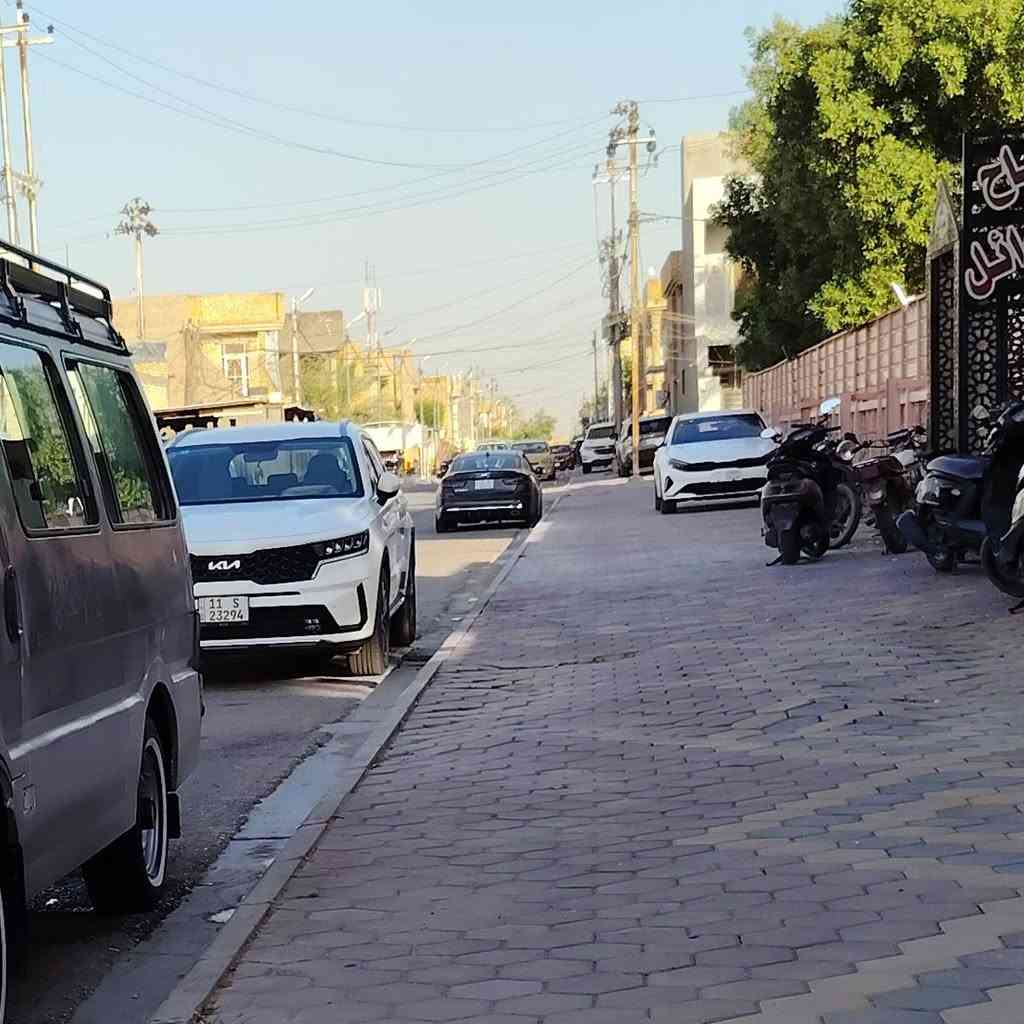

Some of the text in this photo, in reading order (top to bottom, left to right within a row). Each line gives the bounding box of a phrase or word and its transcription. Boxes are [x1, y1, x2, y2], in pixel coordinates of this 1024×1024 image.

[207, 559, 241, 571] KIA
[209, 598, 240, 609] 11 S
[209, 610, 244, 621] 23294
